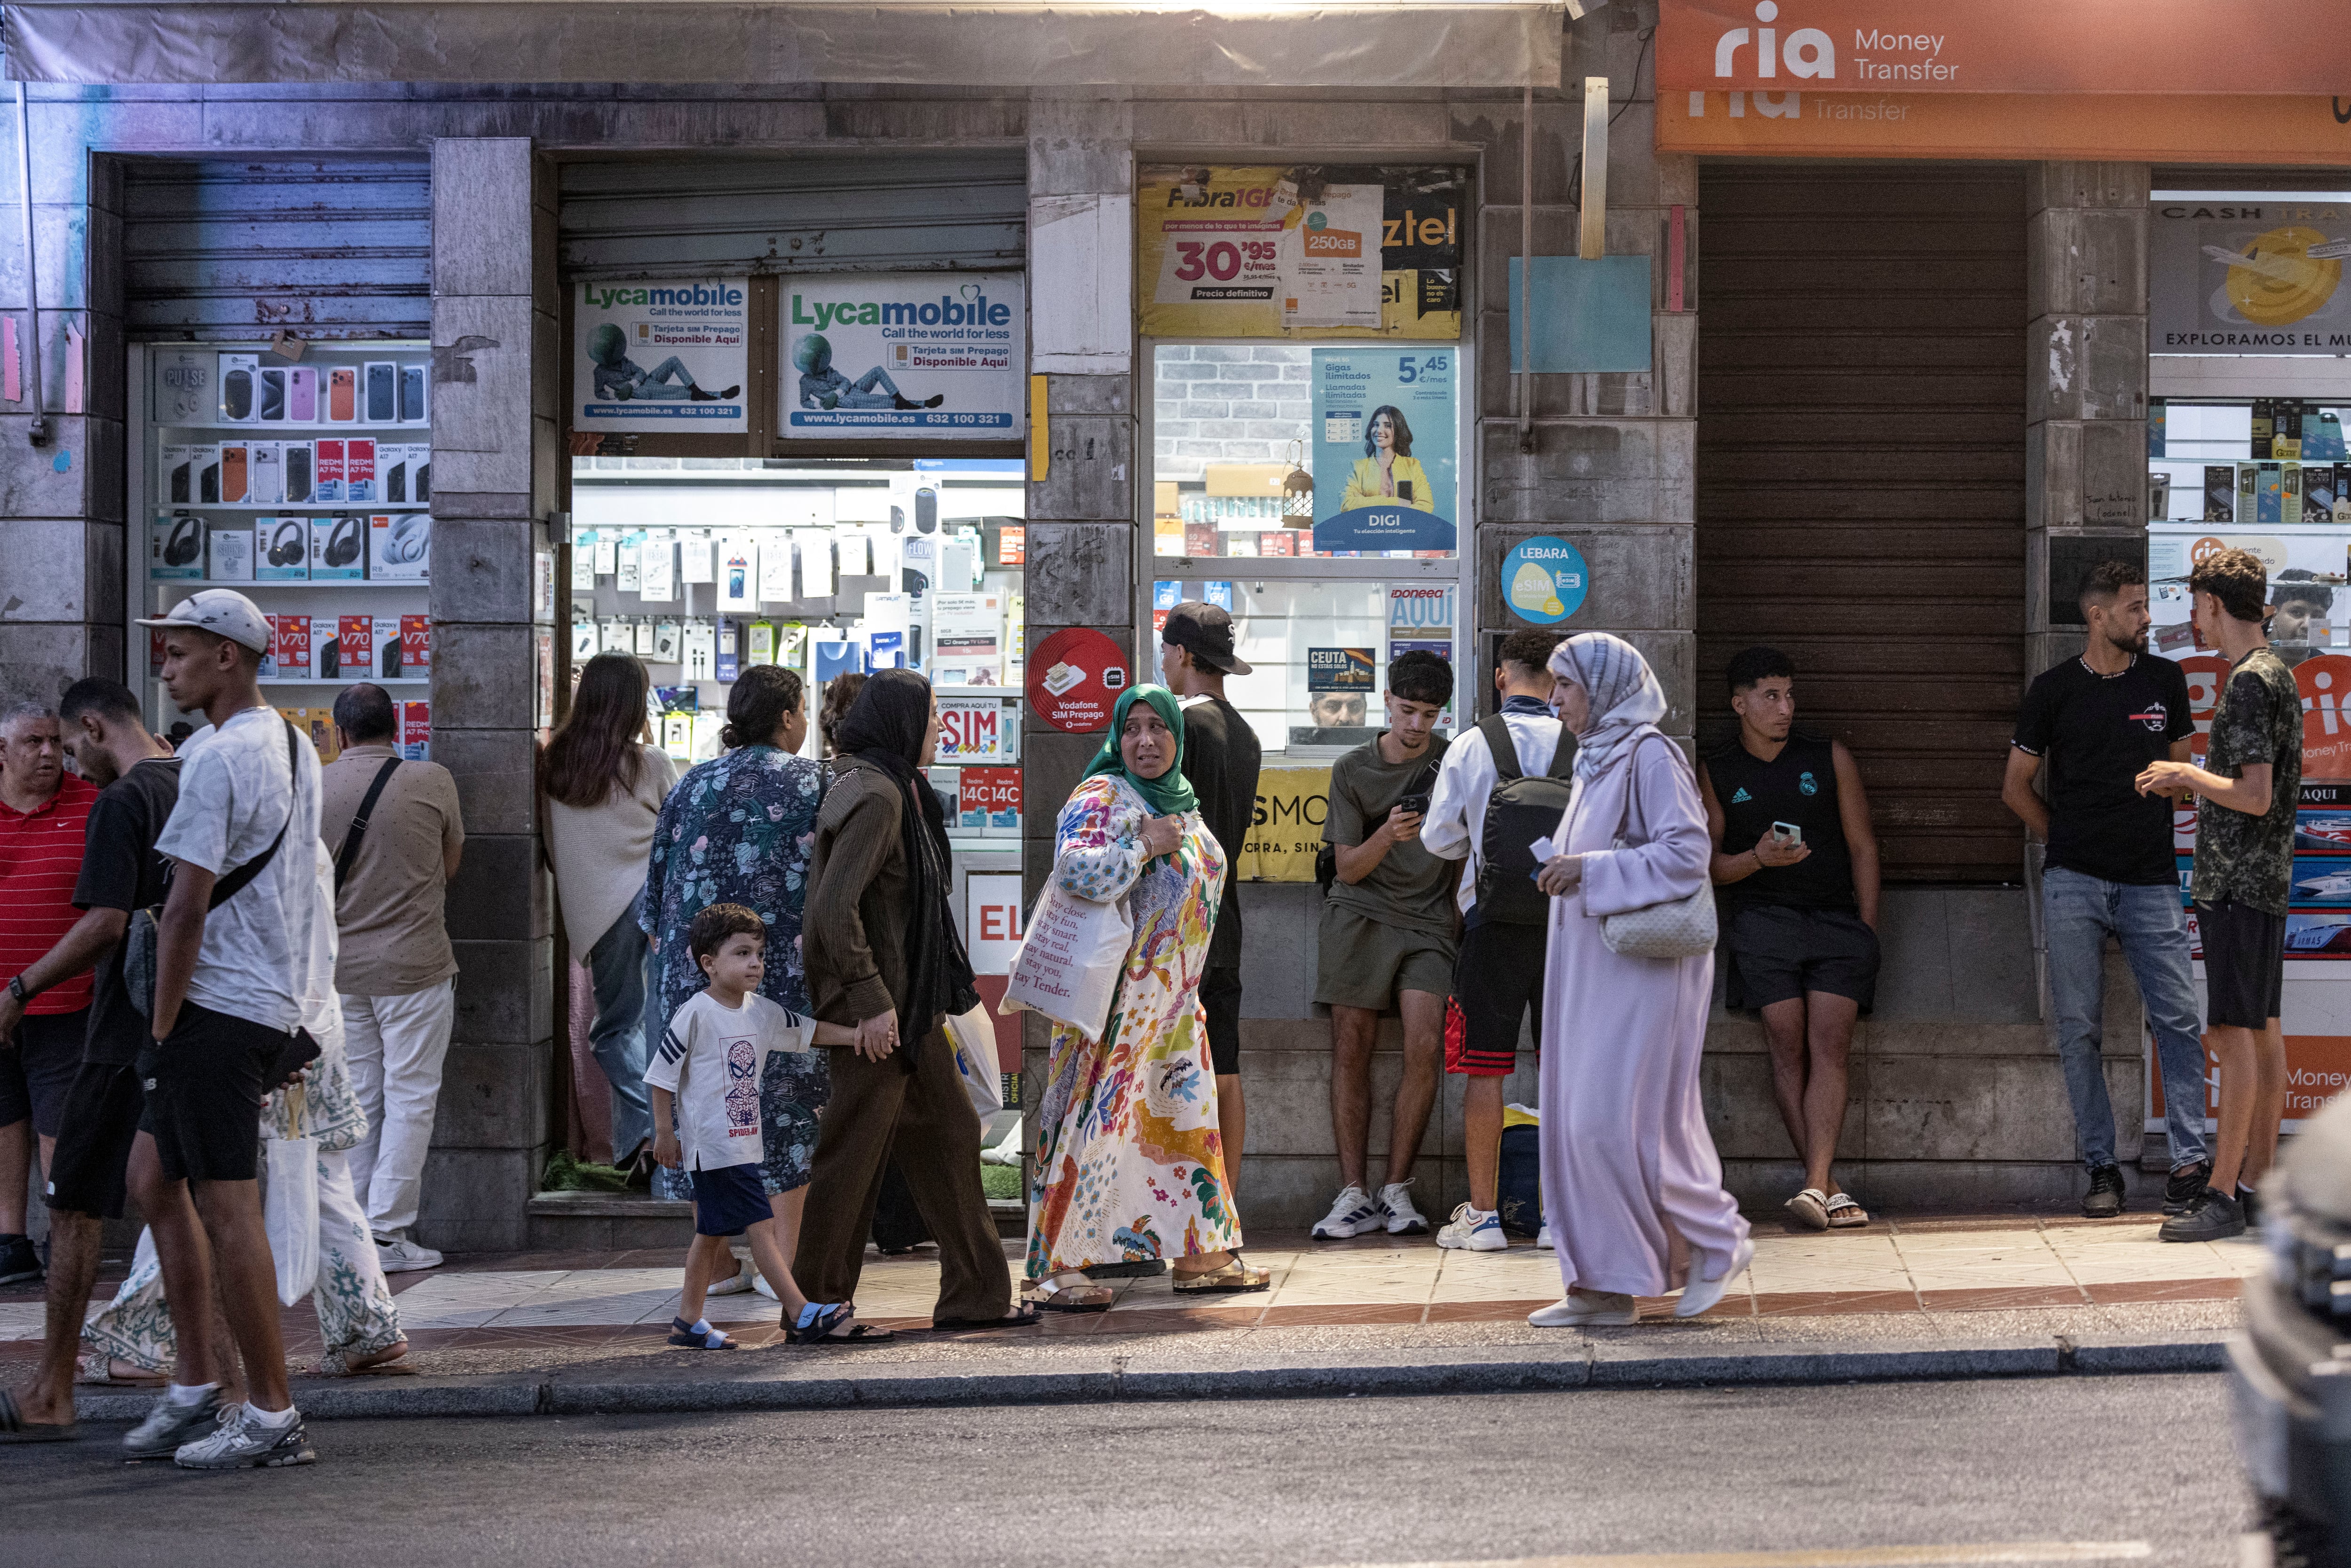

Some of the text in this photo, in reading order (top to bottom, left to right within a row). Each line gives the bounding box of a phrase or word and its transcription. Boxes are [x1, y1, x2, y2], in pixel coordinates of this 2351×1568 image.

[1715, 0, 1835, 79] ria
[1855, 29, 1945, 55] Money
[1854, 58, 1959, 81] Transfer
[1815, 100, 1910, 122] Transfer
[2162, 207, 2261, 219] CASH
[1310, 236, 1356, 250] 250GB
[1244, 262, 1276, 271] €/mes
[584, 283, 743, 309] Lycamobile
[649, 308, 667, 316] Call
[792, 294, 1010, 331] Lycamobile
[653, 325, 684, 334] Tarjeta
[703, 325, 740, 335] Prepago
[882, 328, 1010, 339] Call the world for less
[654, 335, 711, 345] Disponible
[2166, 333, 2296, 346] EXPLORAMOS
[2304, 334, 2321, 346] EL
[912, 346, 947, 355] Tarjeta
[968, 347, 1009, 356] Prepago
[913, 356, 977, 369] Disponible
[593, 407, 673, 415] www.lycamobile.es
[804, 414, 1000, 425] www.lycamobile.es 632 100 321
[1368, 515, 1400, 527] DIGI
[908, 543, 932, 555] FLOW
[1520, 548, 1569, 559] LEBARA
[1515, 580, 1550, 592] eSIM
[279, 633, 308, 646] V70
[341, 632, 370, 645] V70
[1310, 651, 1347, 663] CEUTA
[1058, 701, 1099, 710] Vodafone
[1069, 711, 1104, 719] Prepago
[942, 710, 996, 747] SIM
[961, 786, 989, 802] 14C
[991, 786, 1019, 802] 14C
[2302, 789, 2337, 801] AQUI
[1049, 893, 1087, 920] Stay close,
[1046, 908, 1078, 930] stay fun,
[1036, 917, 1078, 943] stay smart,
[1034, 932, 1069, 953] stay real,
[1040, 948, 1073, 968] natural,
[1025, 957, 1062, 979] stay you,
[1033, 975, 1071, 998] Tender.
